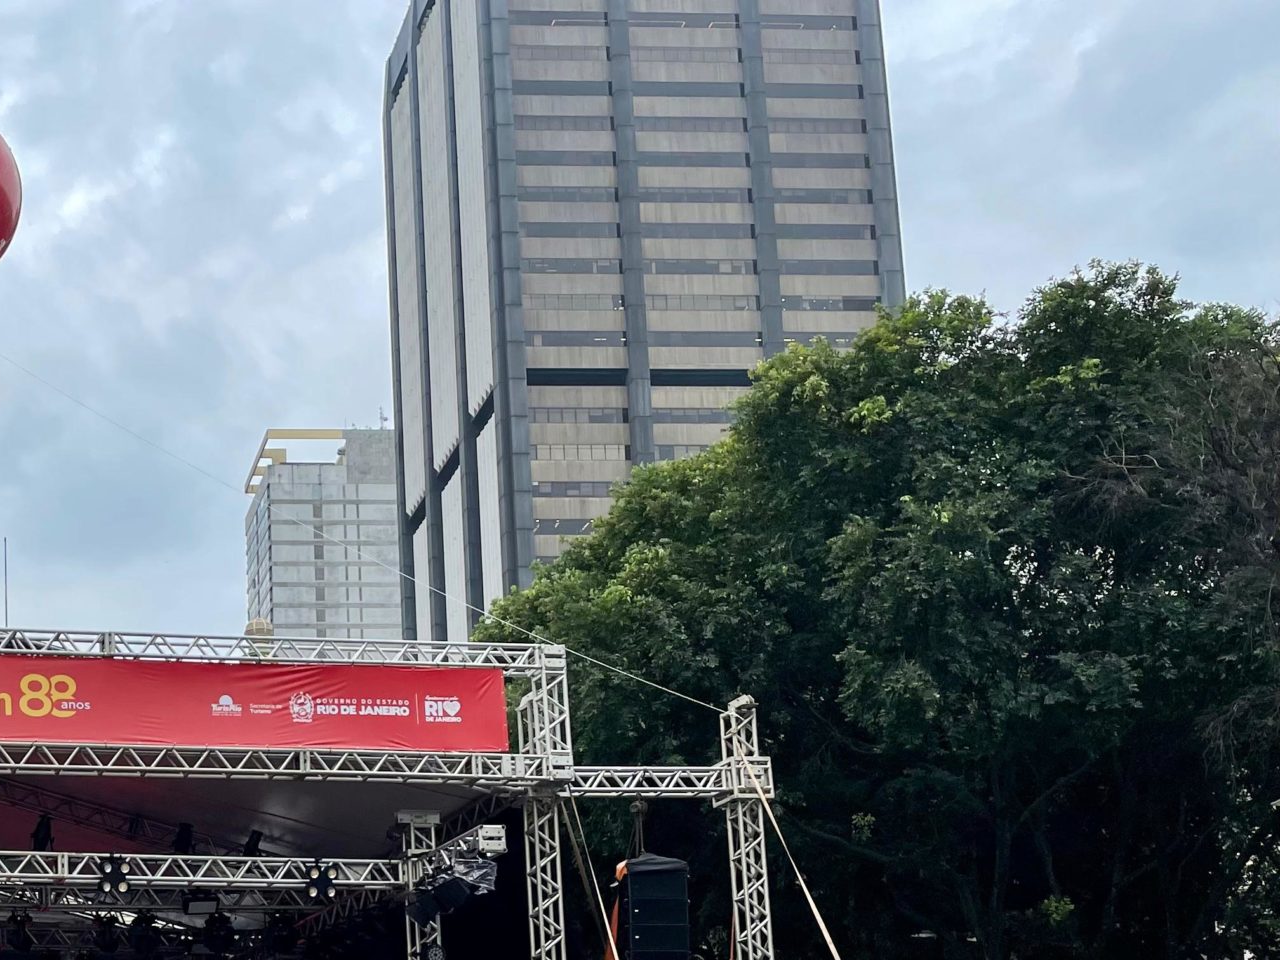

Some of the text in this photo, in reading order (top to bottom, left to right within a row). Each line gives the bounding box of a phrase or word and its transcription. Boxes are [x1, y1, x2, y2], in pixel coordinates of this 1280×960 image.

[18, 673, 77, 718] 88
[60, 700, 91, 710] anos
[316, 705, 410, 716] RIO DE JANEIRO
